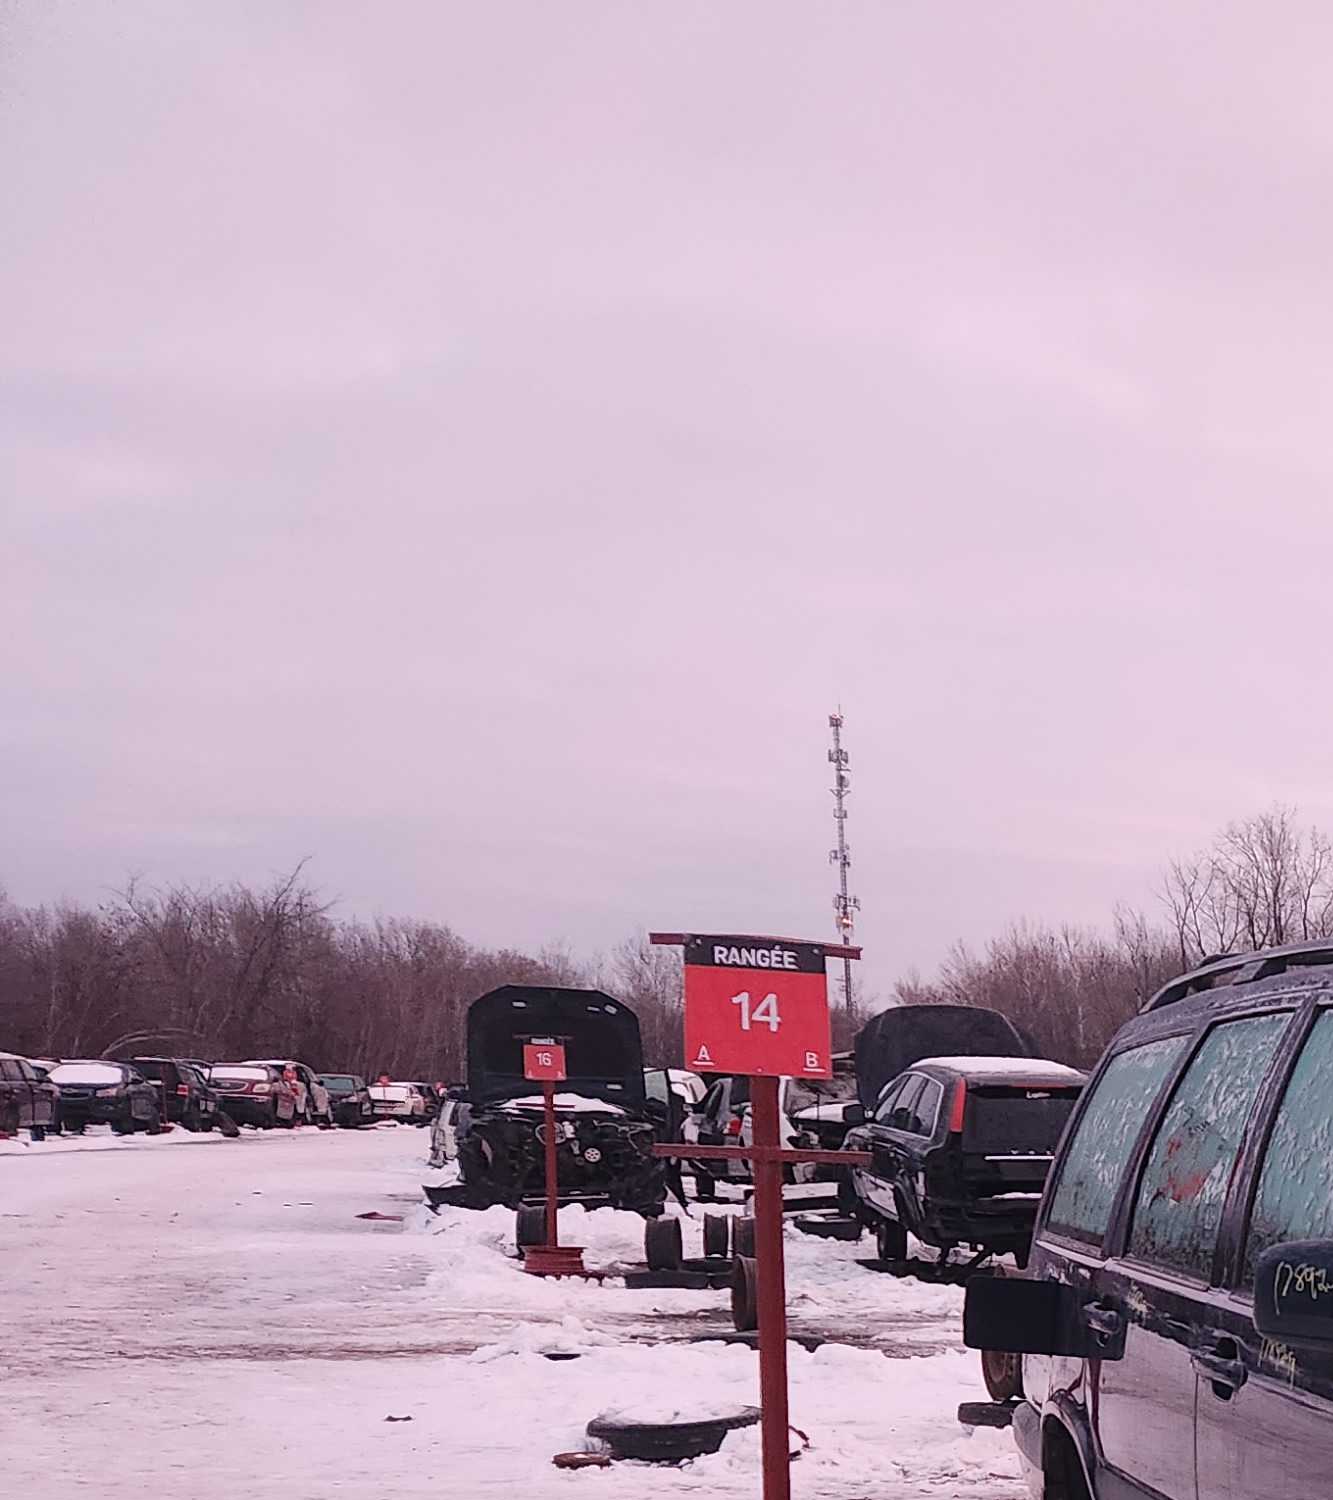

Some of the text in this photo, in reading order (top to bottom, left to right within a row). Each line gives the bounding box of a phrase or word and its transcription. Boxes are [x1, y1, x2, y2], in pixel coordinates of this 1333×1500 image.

[713, 944, 799, 970] RANGÉE
[730, 991, 782, 1033] 14
[535, 1052, 553, 1067] 16
[697, 1045, 710, 1061] A
[805, 1051, 819, 1068] B
